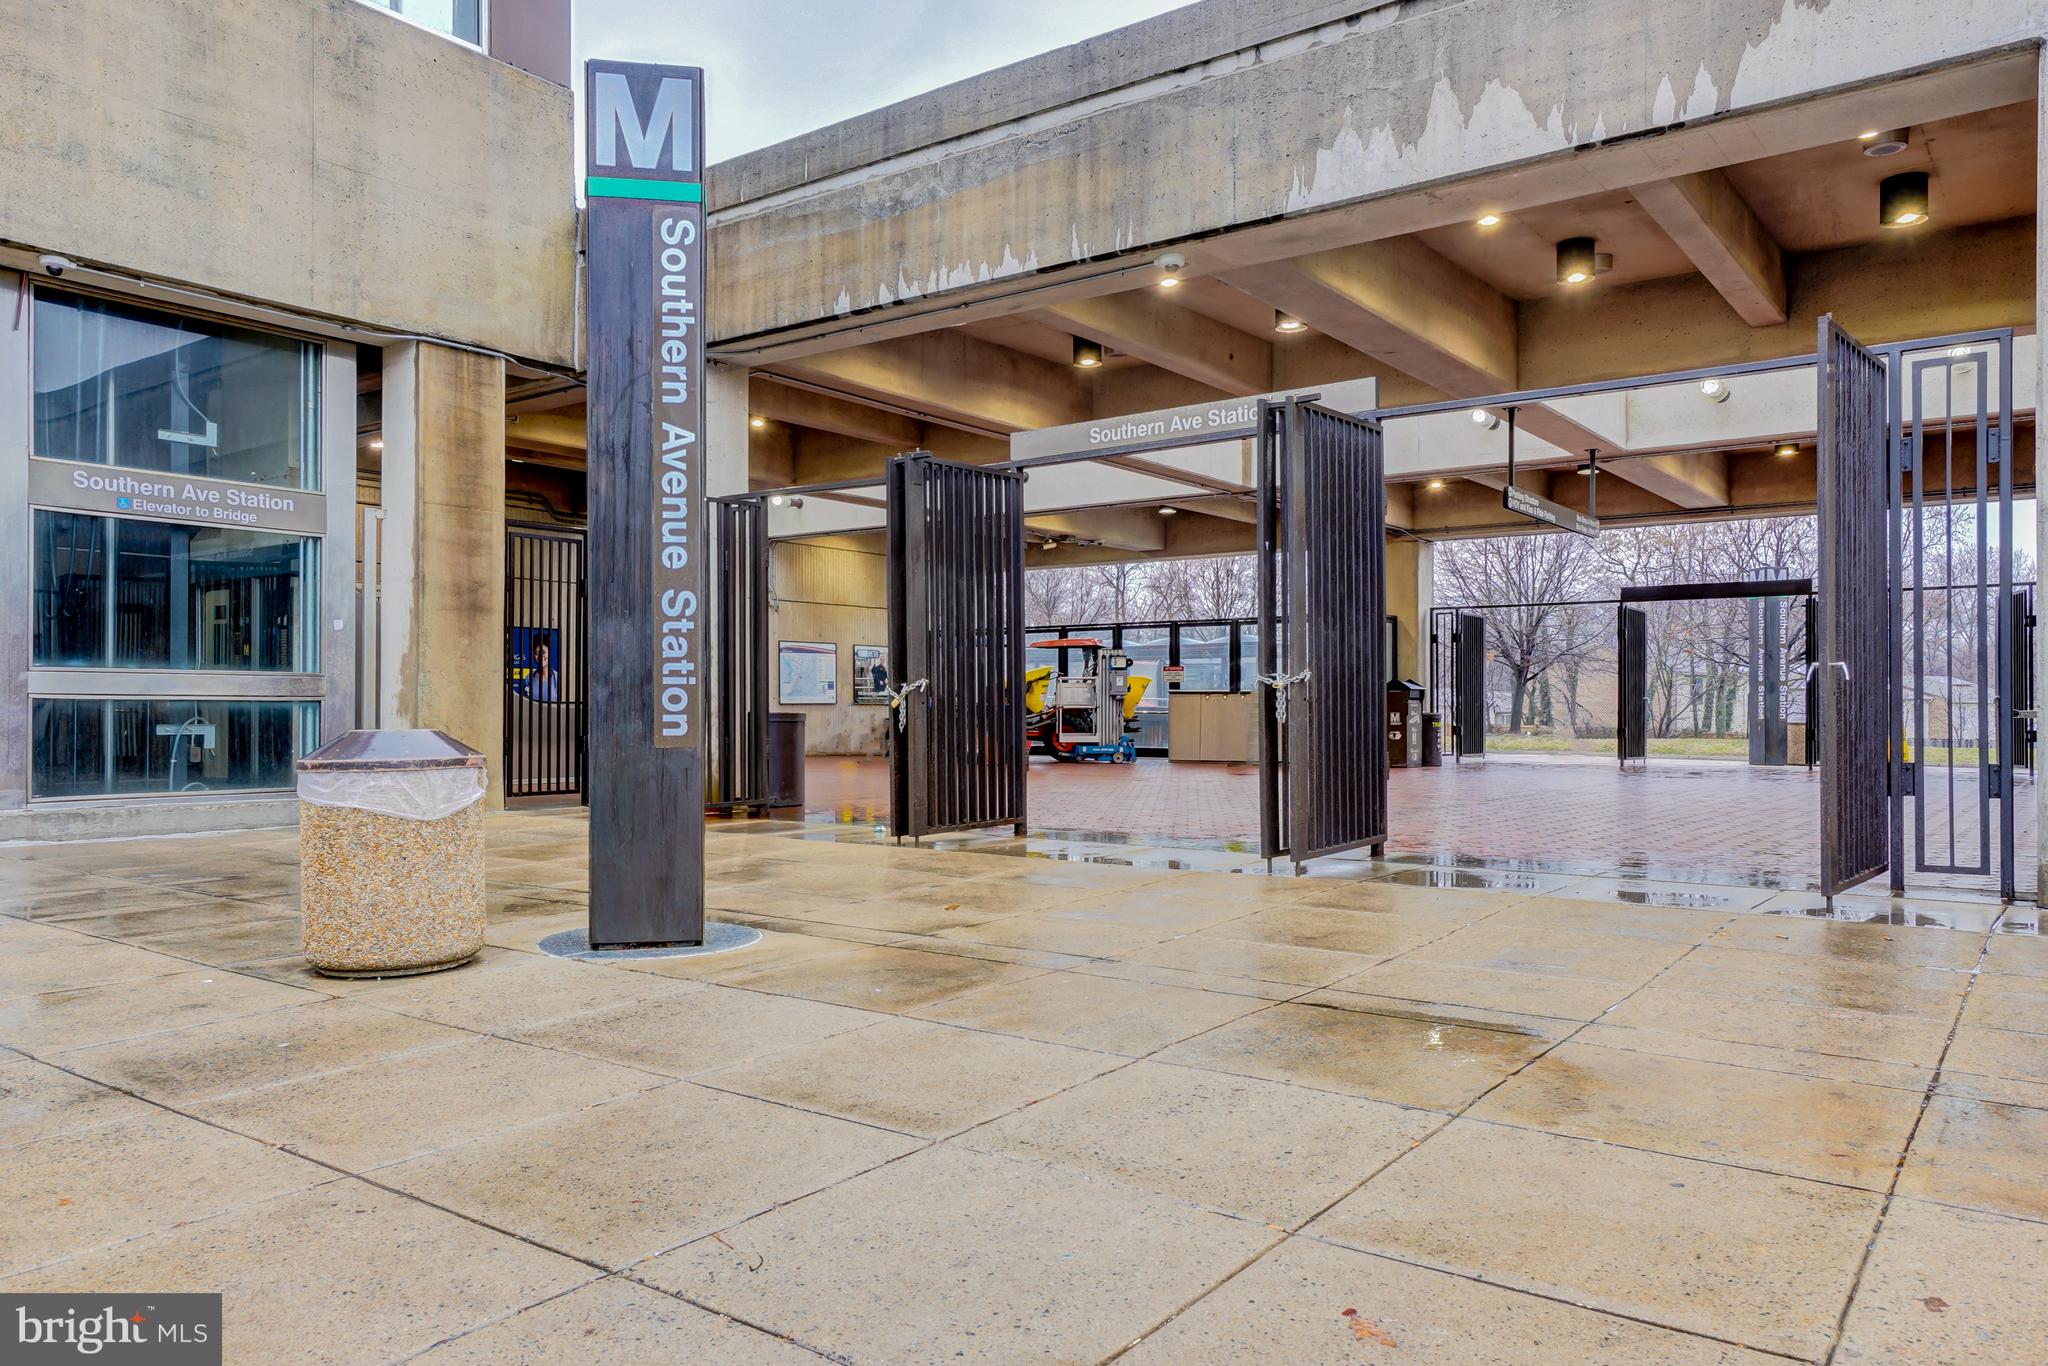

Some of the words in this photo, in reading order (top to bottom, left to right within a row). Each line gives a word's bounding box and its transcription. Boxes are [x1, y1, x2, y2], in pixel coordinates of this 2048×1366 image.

[595, 72, 692, 172] M
[660, 217, 696, 404] Southern
[1089, 420, 1165, 444] Southern
[1170, 415, 1202, 433] Ave
[1207, 405, 1258, 427] Statio
[72, 470, 175, 498] Southern
[181, 484, 220, 503] Ave
[226, 488, 294, 512] Station
[133, 498, 192, 516] Elevator
[195, 505, 209, 518] to
[213, 507, 257, 524] Bridge
[660, 422, 696, 570] Avenue
[1780, 601, 1788, 645] Southern
[660, 588, 698, 737] Station
[1780, 648, 1788, 682] Avenue
[1780, 685, 1788, 720] Station
